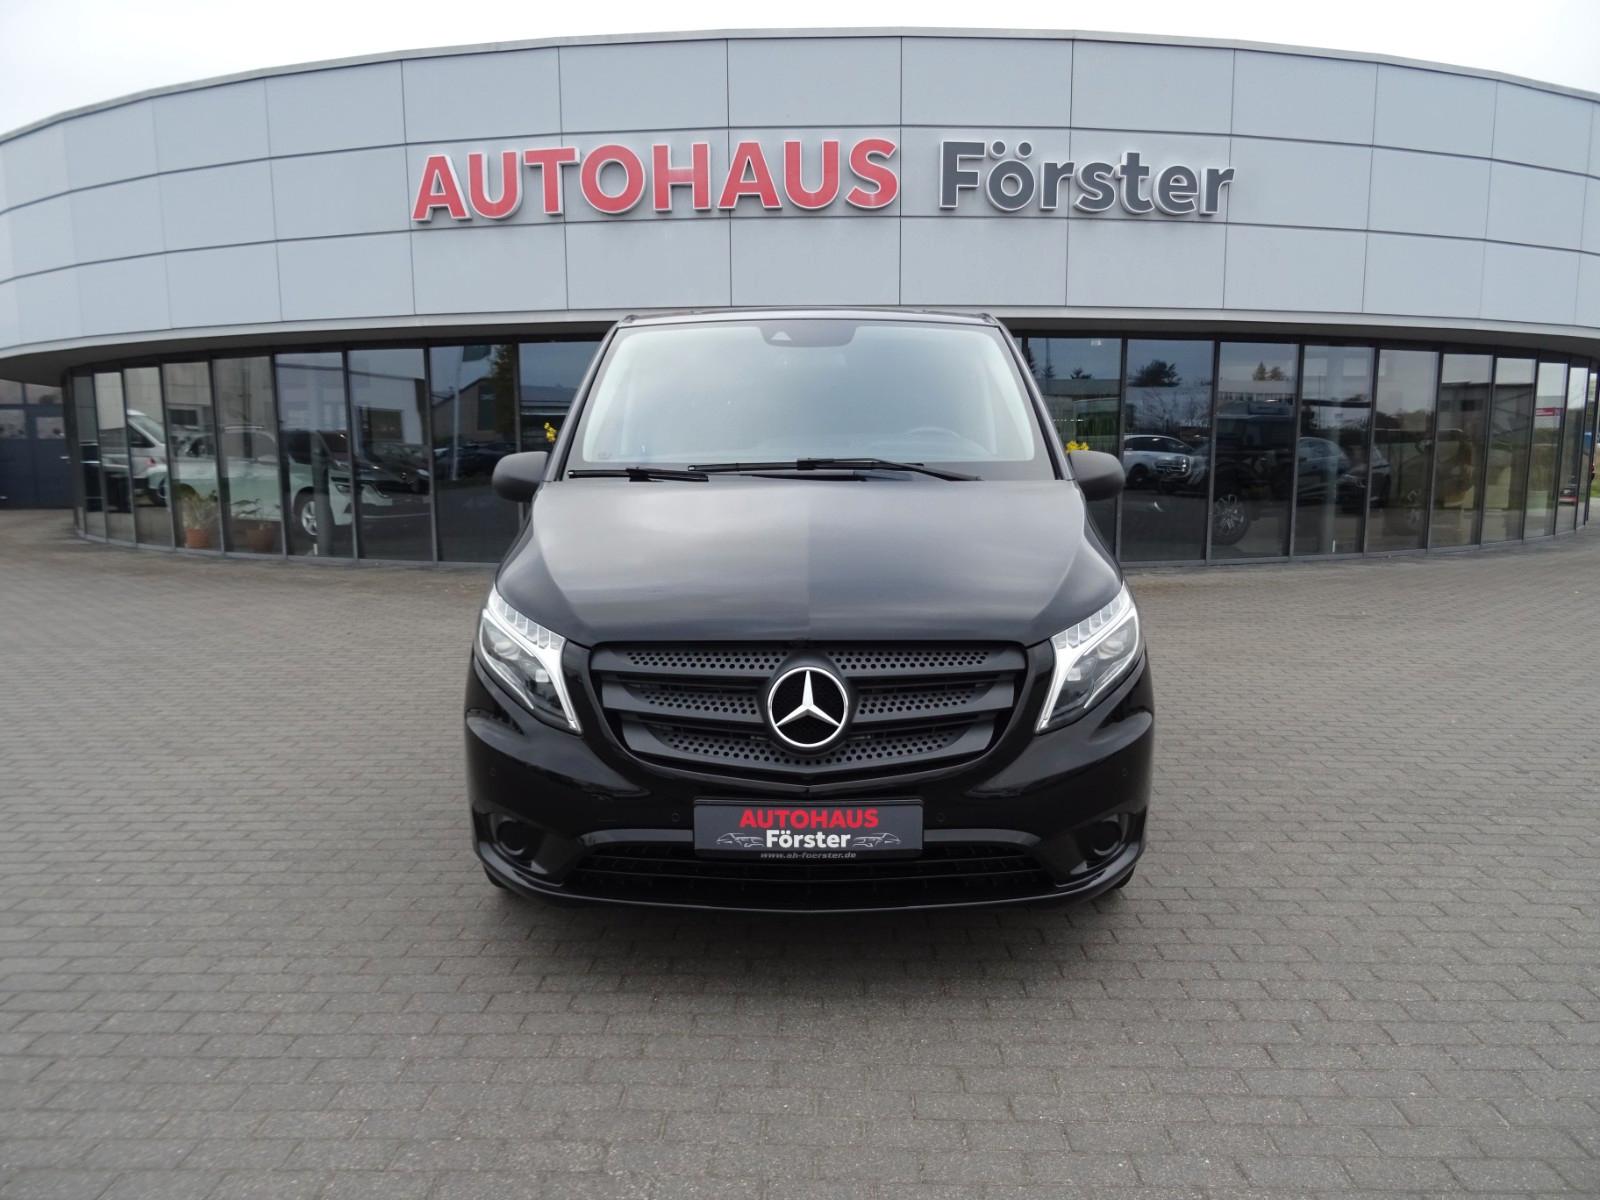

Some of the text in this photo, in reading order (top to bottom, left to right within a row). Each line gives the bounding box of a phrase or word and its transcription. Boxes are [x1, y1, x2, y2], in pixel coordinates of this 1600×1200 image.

[412, 139, 1234, 222] AUTOHAUS Förster
[740, 808, 878, 828] AUTOHAUS
[766, 829, 851, 848] Förster
[760, 851, 856, 859] www.ah-foerster.de
